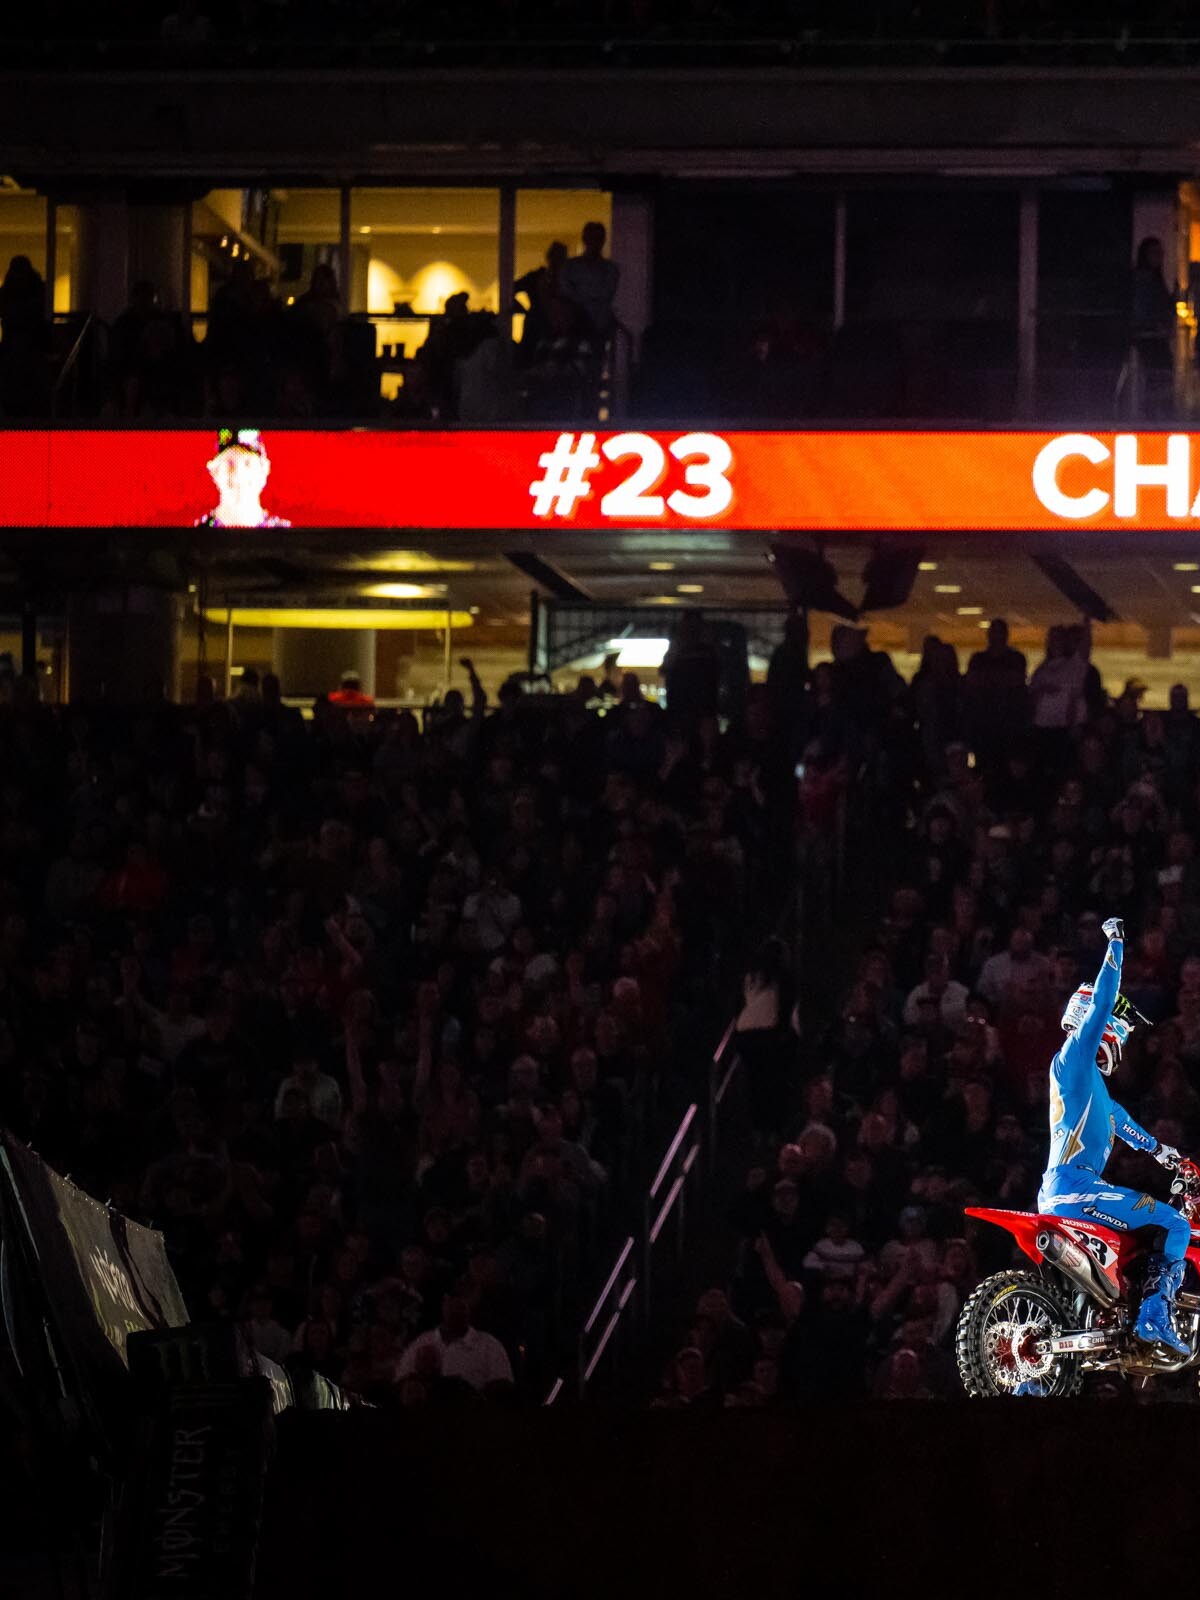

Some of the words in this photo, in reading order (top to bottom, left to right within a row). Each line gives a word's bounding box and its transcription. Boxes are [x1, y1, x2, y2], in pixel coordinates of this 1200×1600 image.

[529, 433, 734, 519] #23
[1061, 1217, 1098, 1231] HONDA
[1092, 1210, 1129, 1230] HONDA
[154, 1424, 213, 1577] MONSTER
